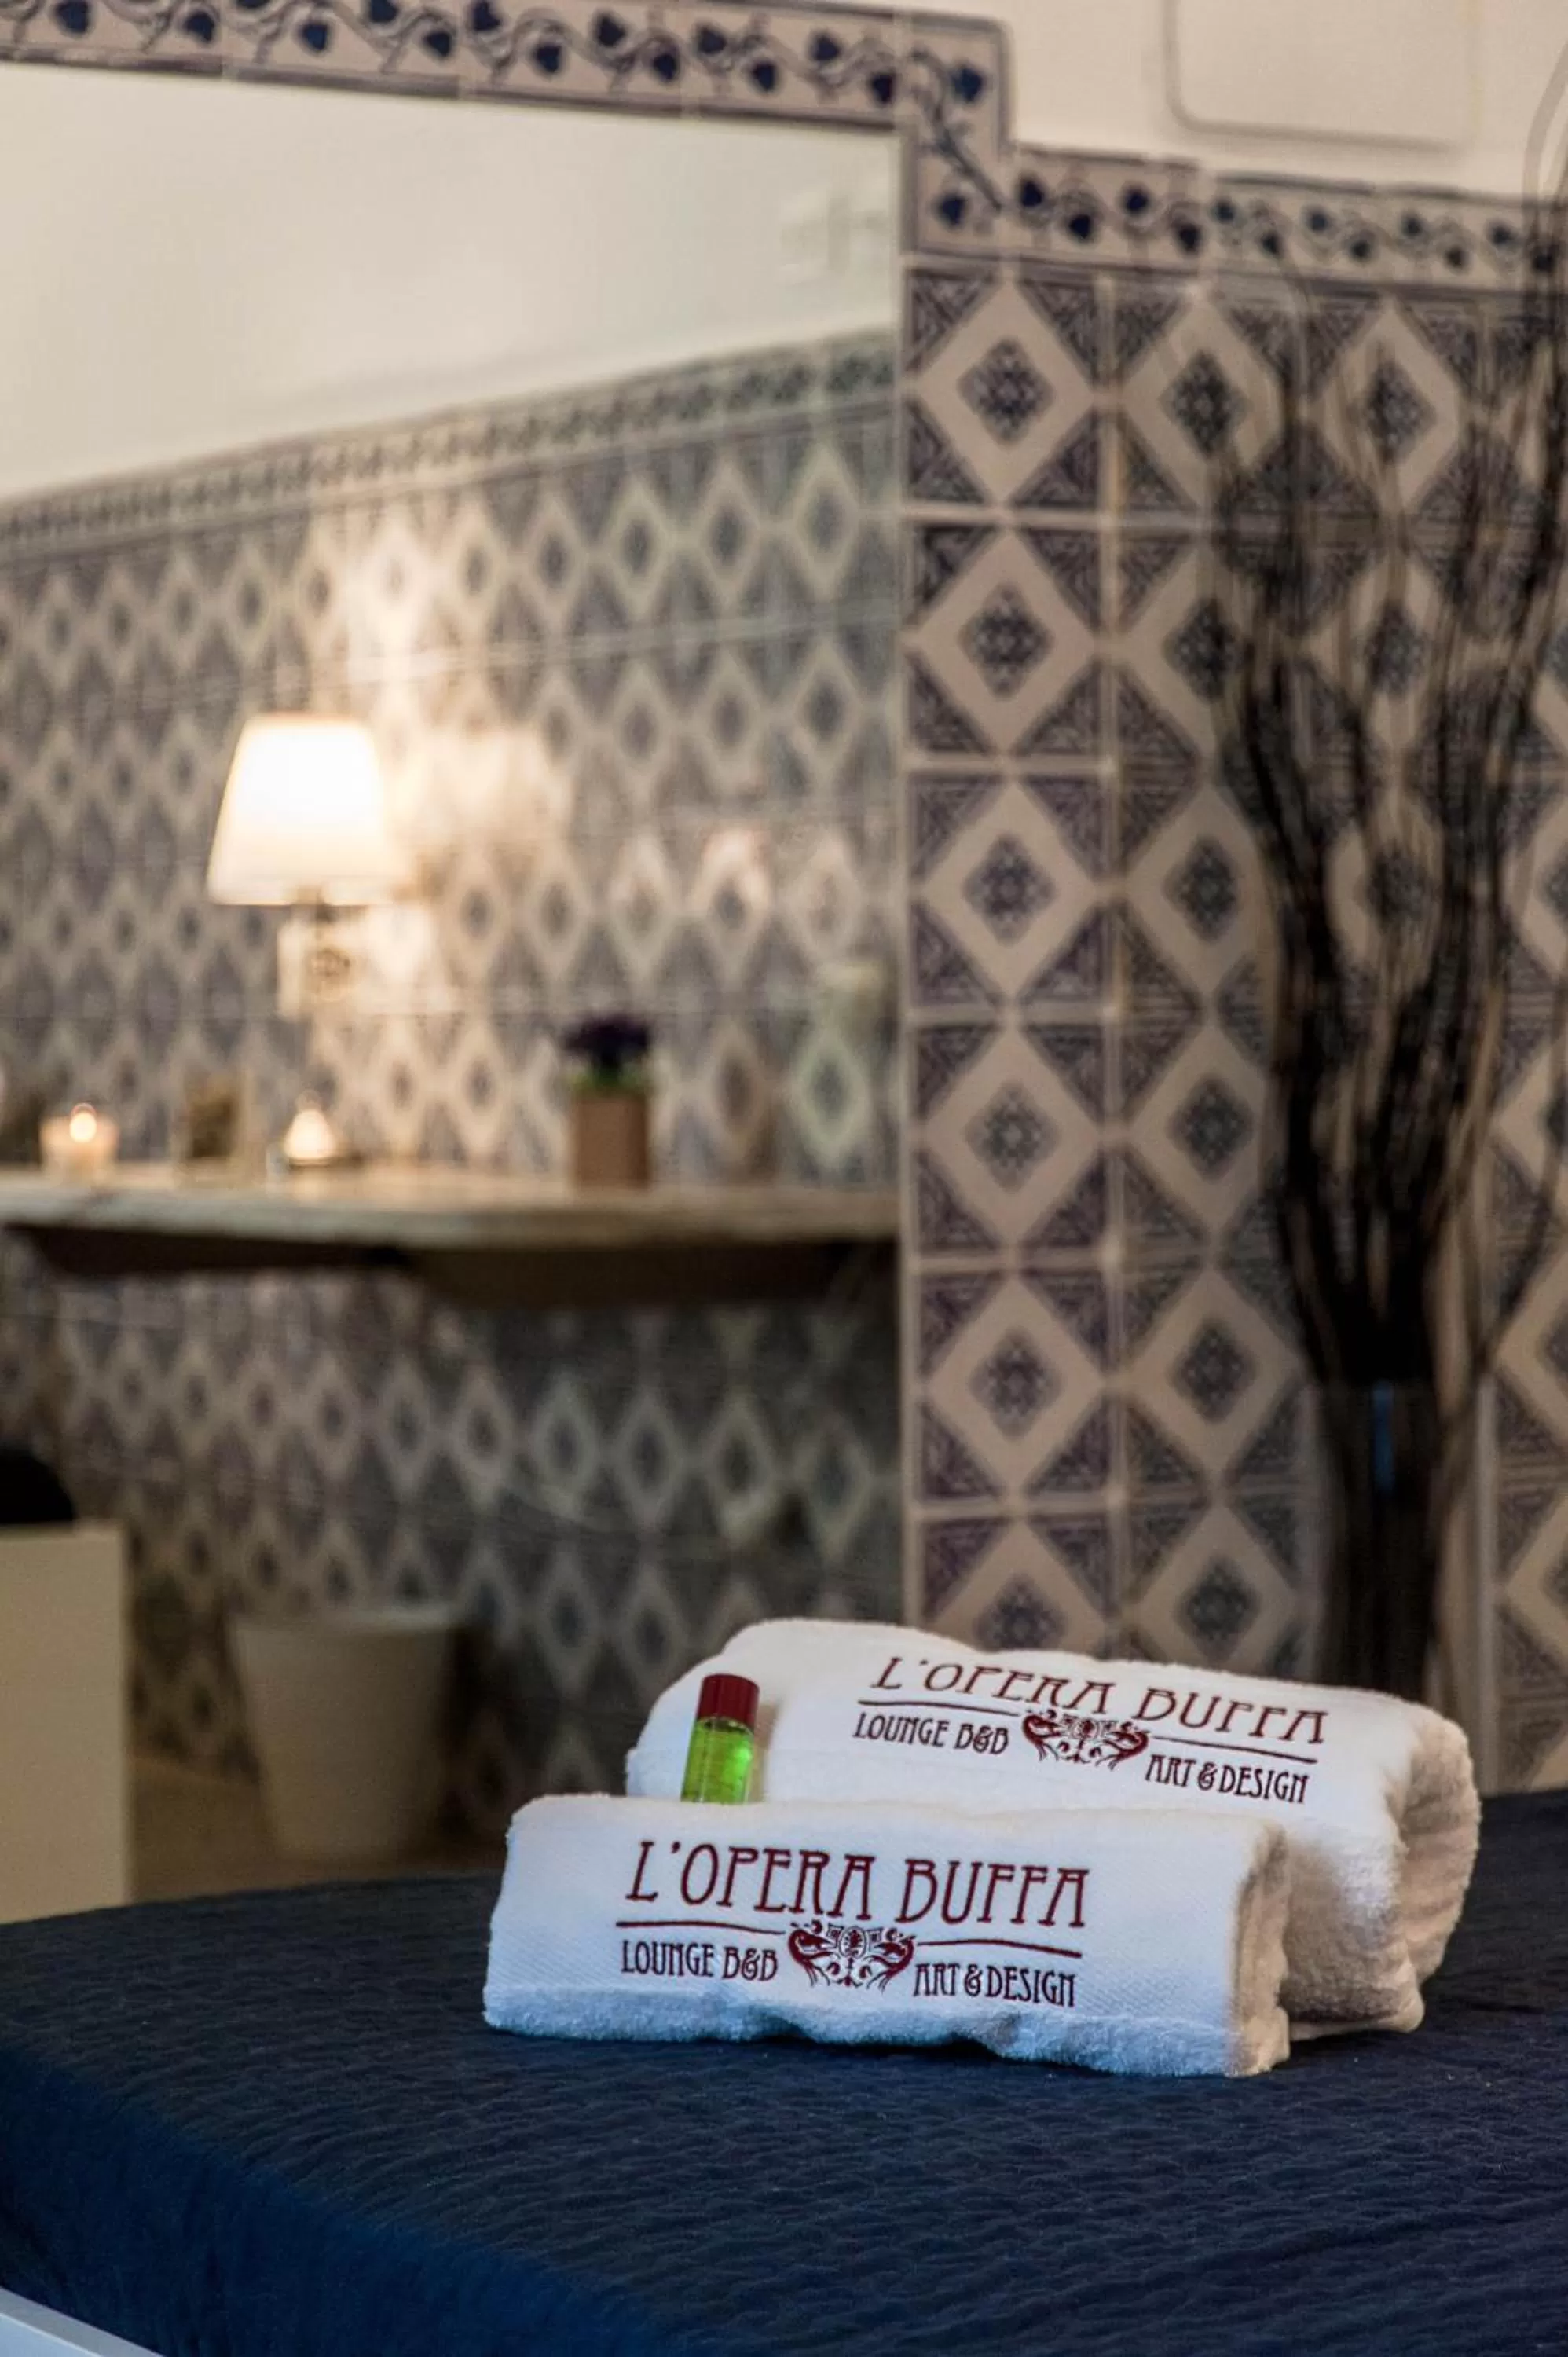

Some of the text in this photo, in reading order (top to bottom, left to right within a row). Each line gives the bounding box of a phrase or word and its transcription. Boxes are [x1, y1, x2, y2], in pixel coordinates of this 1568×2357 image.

[870, 1657, 1328, 1743] L'OPERA BUFFA
[852, 1712, 949, 1747] LOUNGE
[954, 1723, 1009, 1754] B&B
[625, 1841, 1089, 1927] L'OPERA BUFFA
[621, 1940, 715, 1978] LOUNGE
[721, 1946, 778, 1981] B&B
